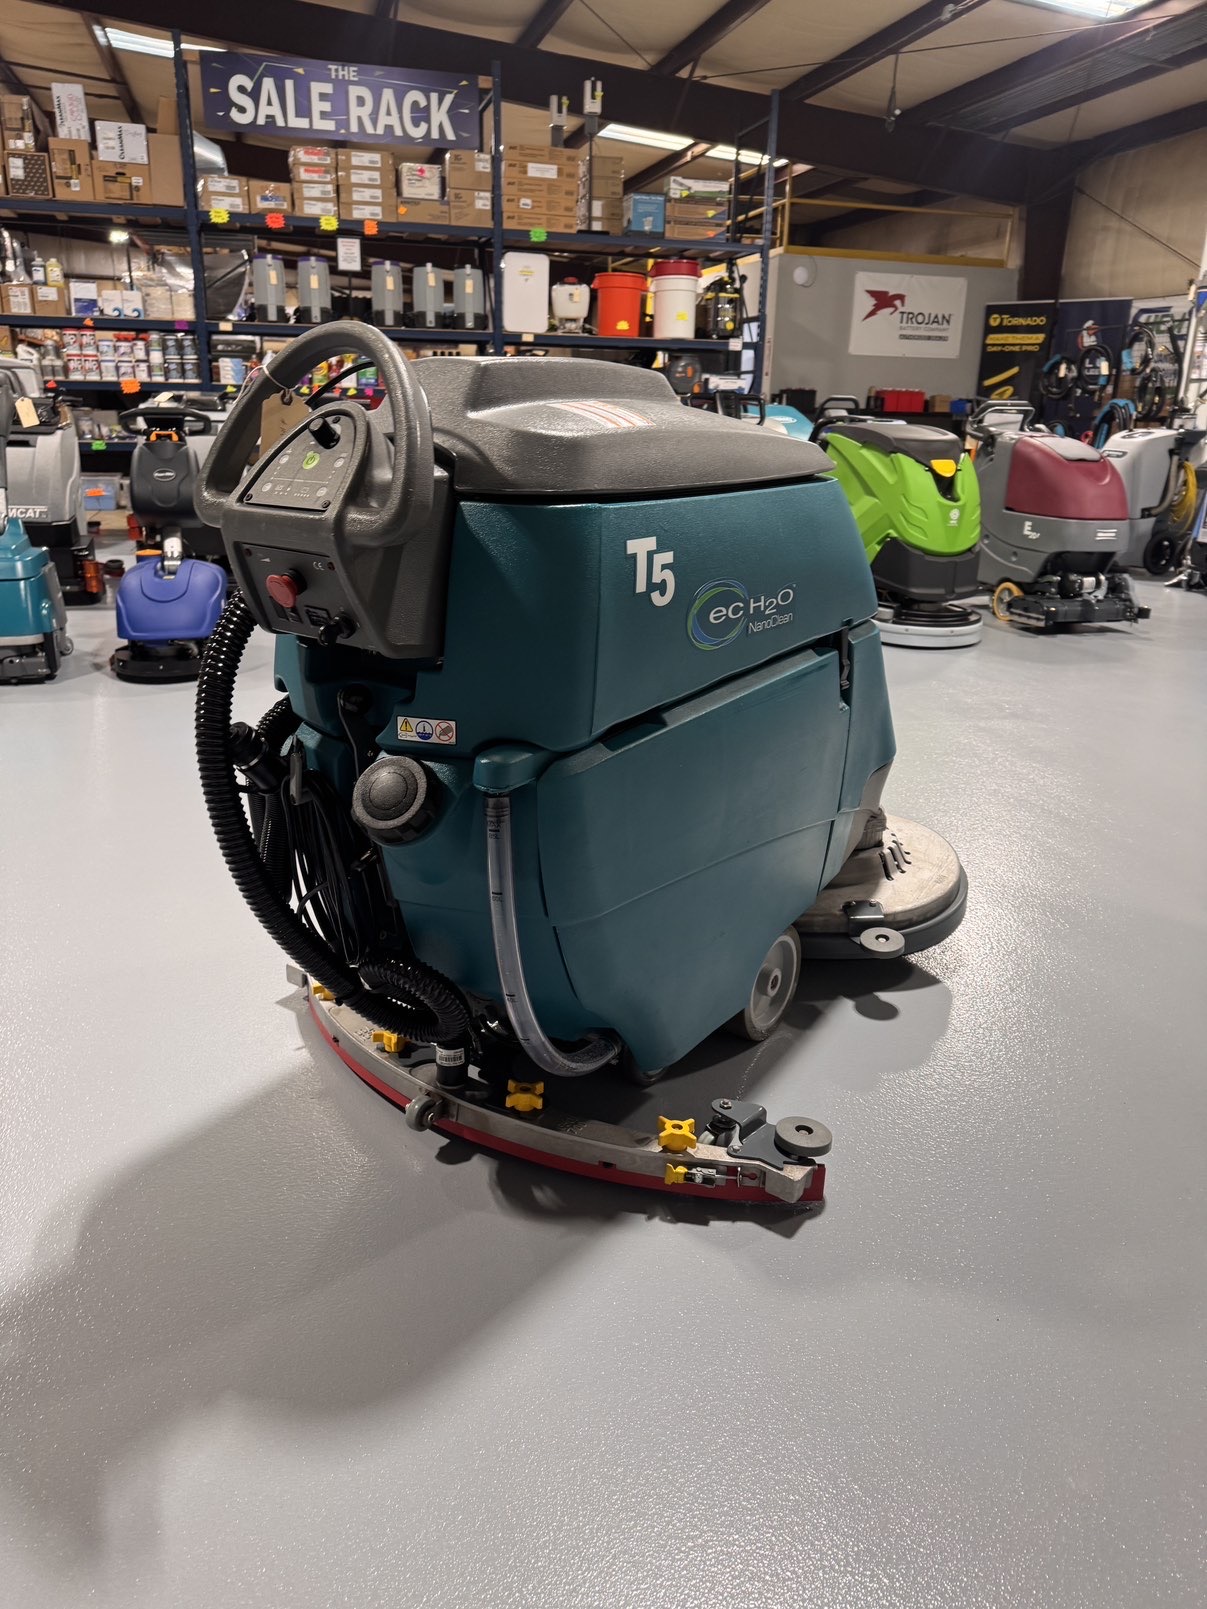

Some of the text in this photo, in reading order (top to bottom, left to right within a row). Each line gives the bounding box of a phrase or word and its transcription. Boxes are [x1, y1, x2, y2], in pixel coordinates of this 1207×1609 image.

[327, 64, 359, 81] THE
[228, 74, 456, 141] SALE RACK
[899, 310, 953, 326] TROJAN
[1001, 314, 1047, 326] TORNADO
[8, 508, 48, 519] MCAT
[626, 536, 676, 607] T5
[747, 612, 793, 635] NanoClean
